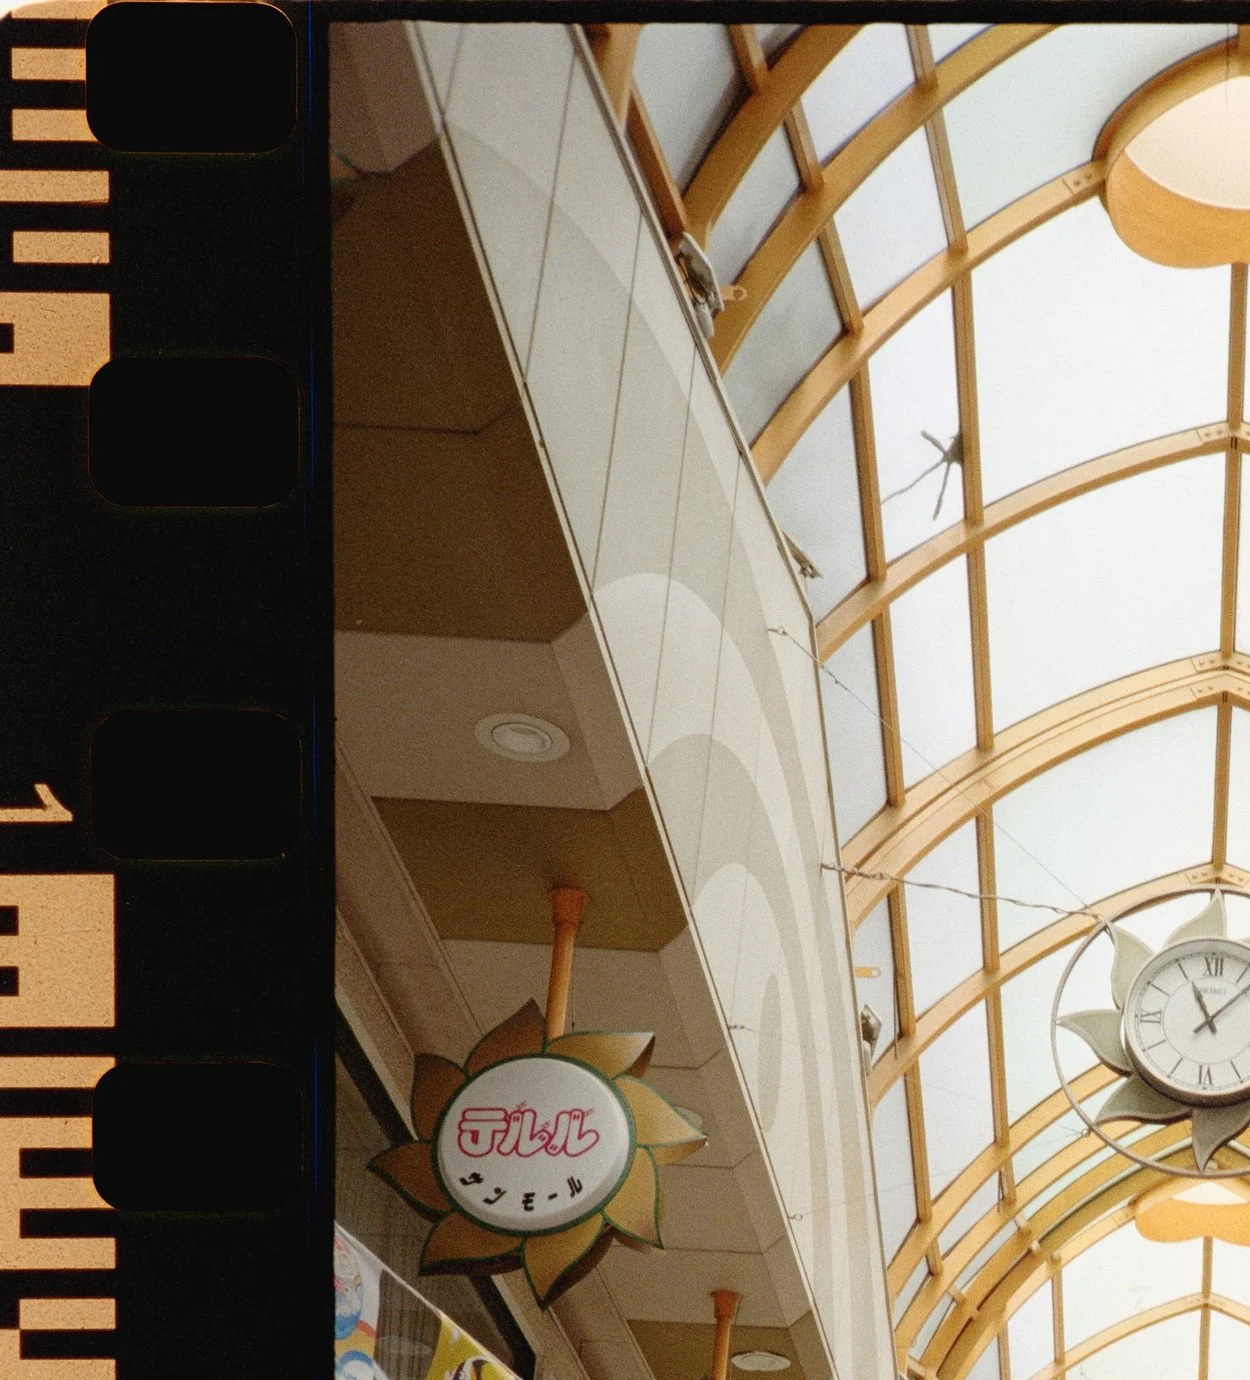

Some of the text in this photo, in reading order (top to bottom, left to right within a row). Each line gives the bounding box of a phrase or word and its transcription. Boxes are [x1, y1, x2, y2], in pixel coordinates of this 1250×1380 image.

[458, 1107, 600, 1158] テルル
[459, 1171, 583, 1212] サンモール
